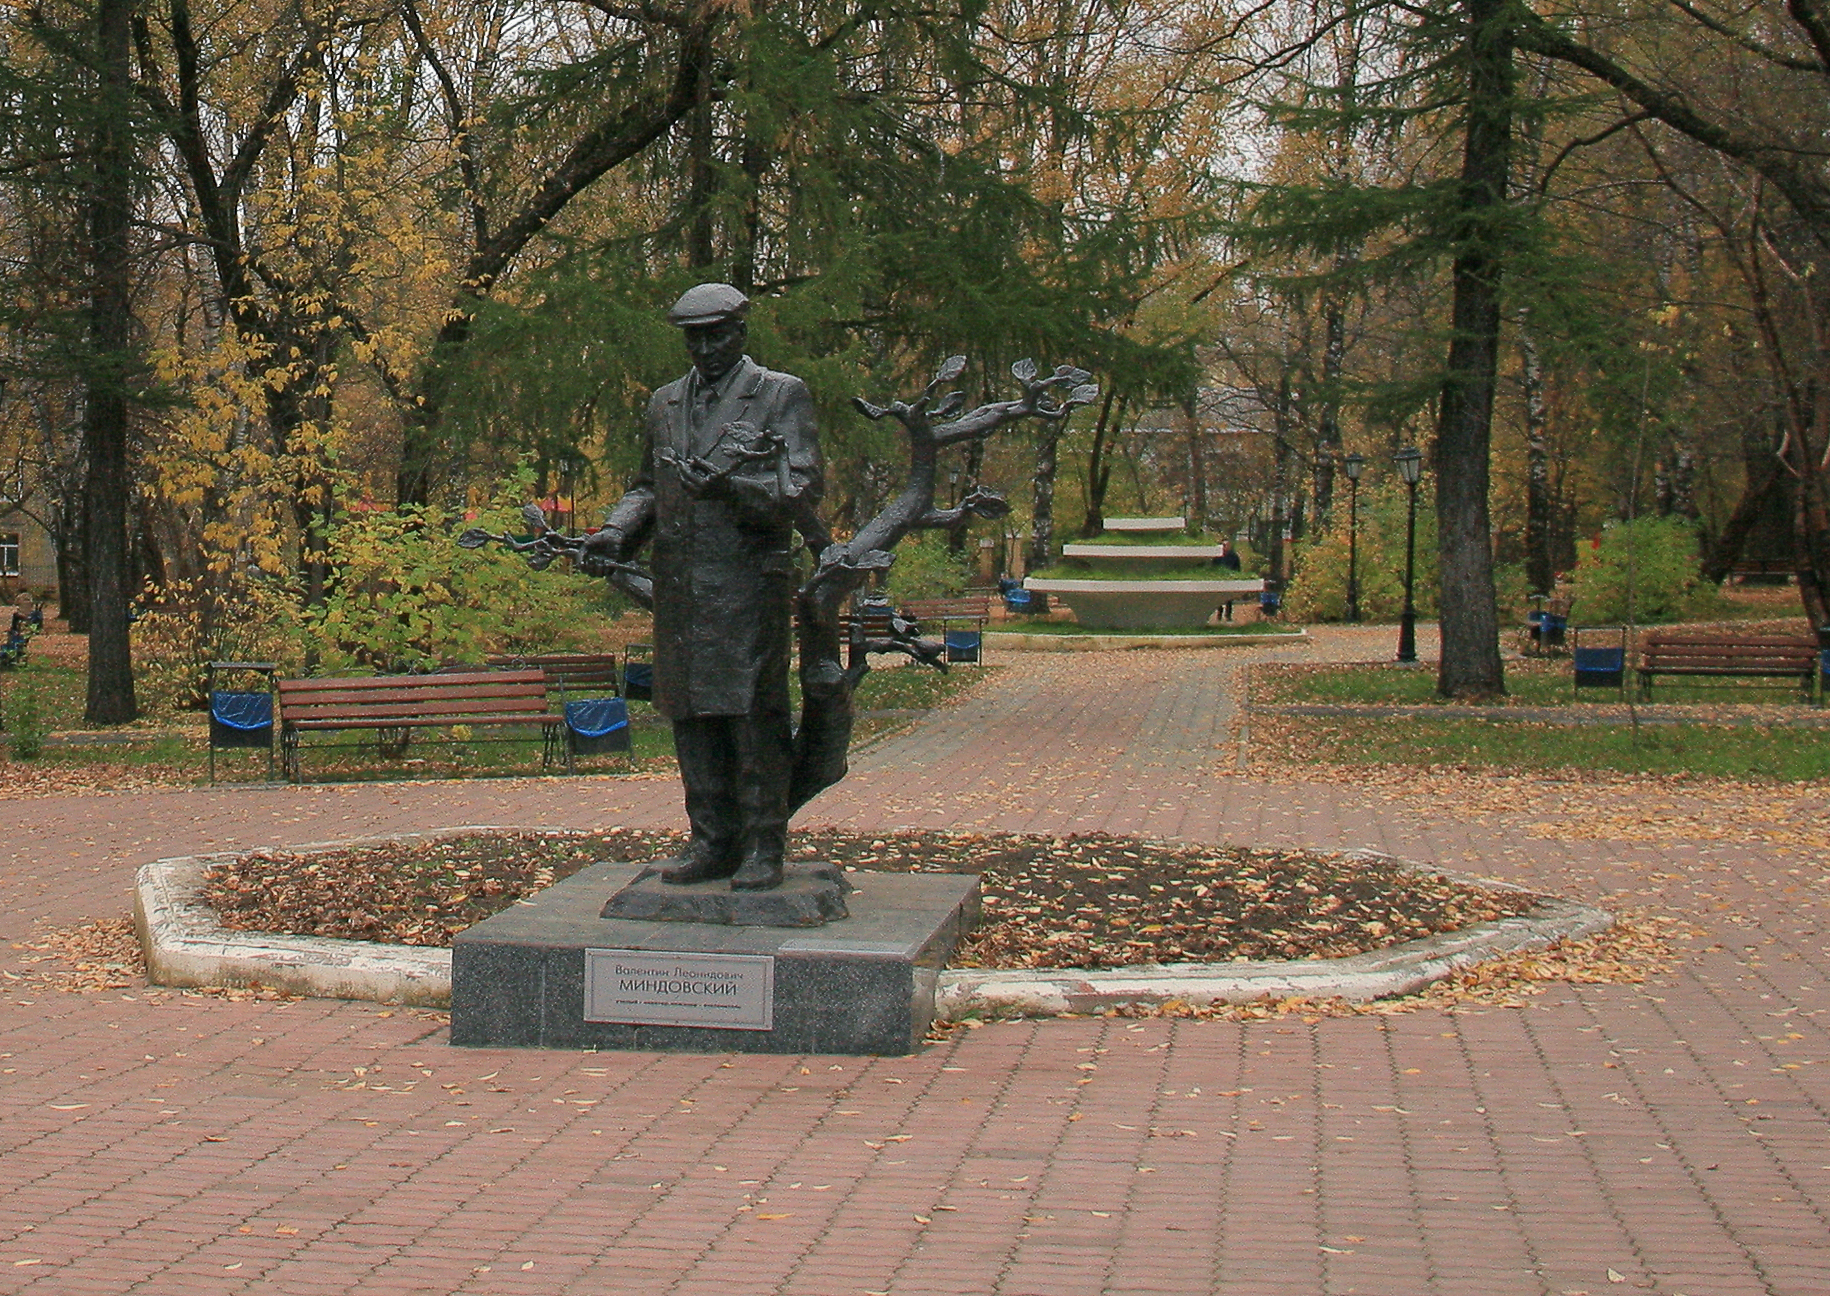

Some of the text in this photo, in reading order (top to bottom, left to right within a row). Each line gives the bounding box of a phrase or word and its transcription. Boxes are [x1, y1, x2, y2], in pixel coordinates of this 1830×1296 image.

[615, 964, 743, 980] Валентин Леонидович
[619, 979, 737, 996] МИНДОВСКИЙ
